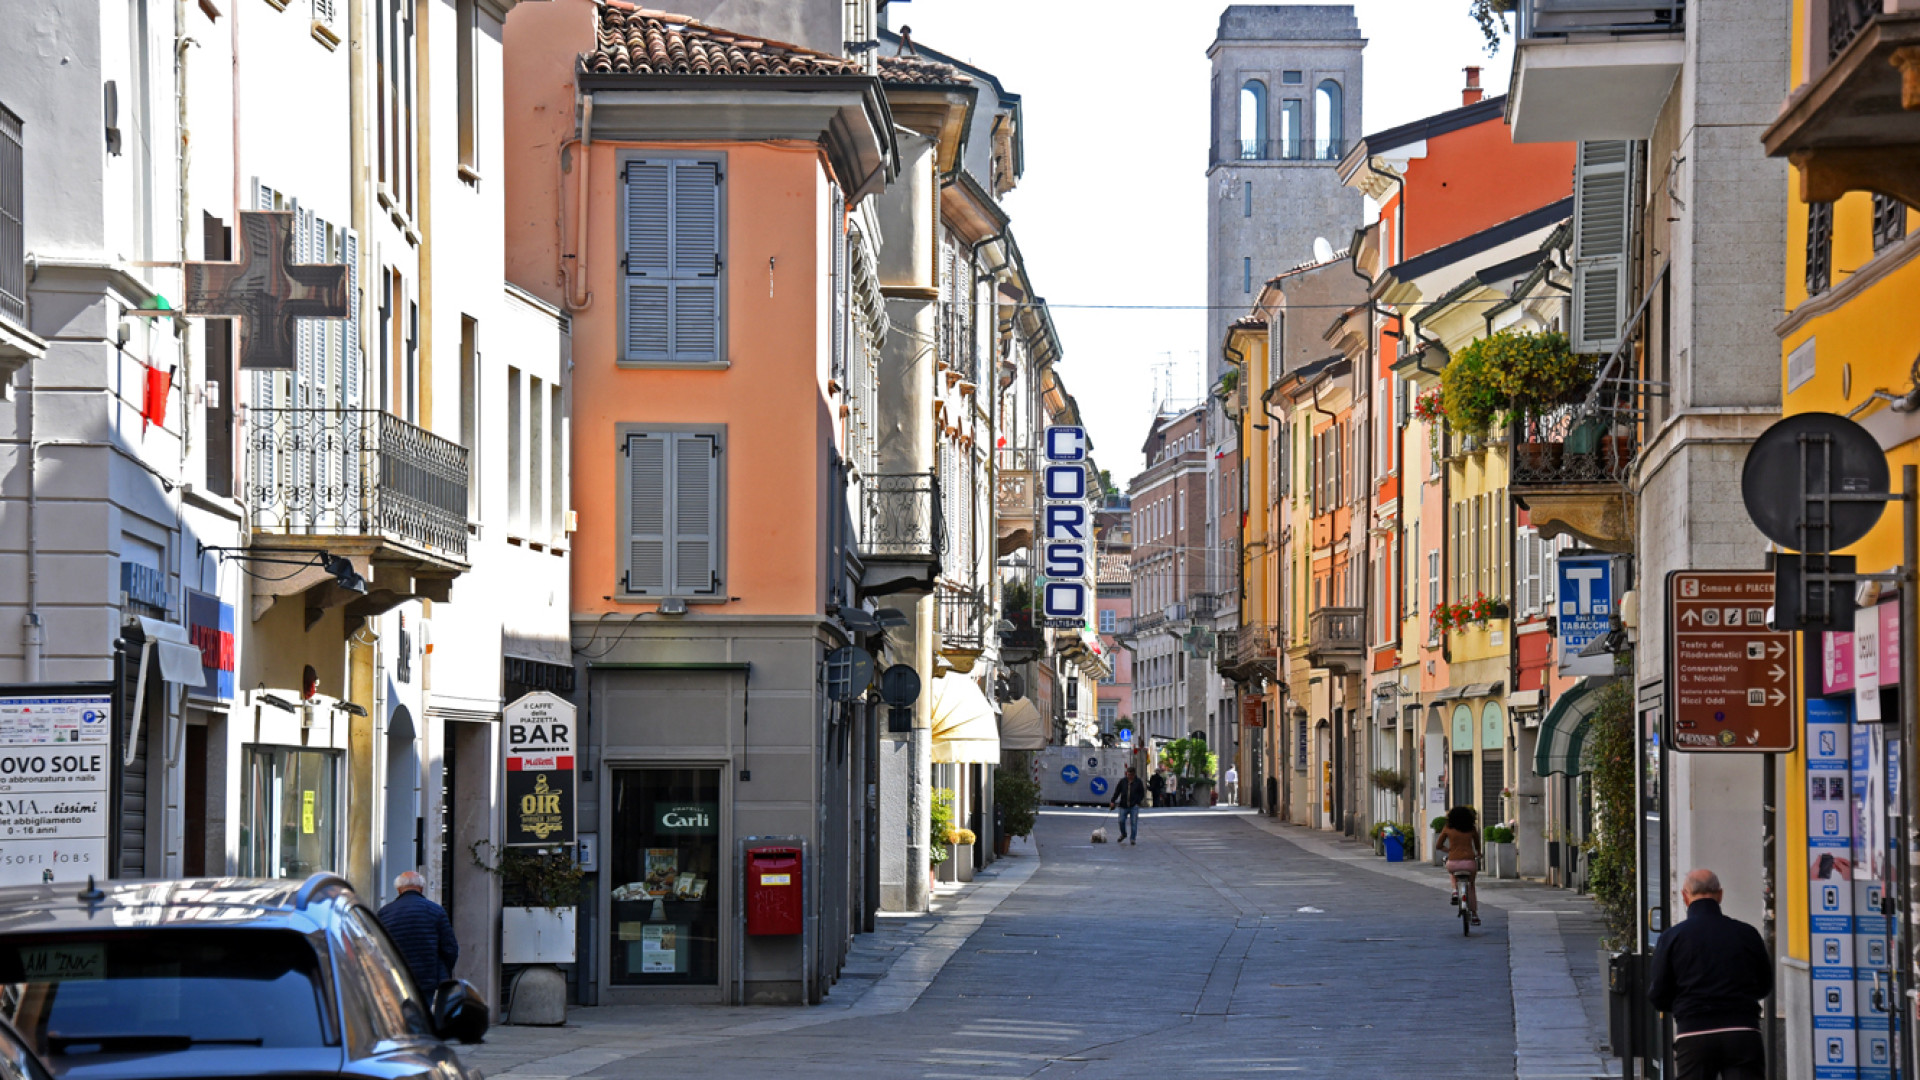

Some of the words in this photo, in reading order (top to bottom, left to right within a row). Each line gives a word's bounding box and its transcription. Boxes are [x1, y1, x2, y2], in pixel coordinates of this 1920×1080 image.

[1046, 428, 1084, 616] CORSO
[1566, 568, 1603, 614] T
[1701, 584, 1732, 593] Comune
[1734, 584, 1742, 593] di
[1746, 584, 1775, 593] PIACEN
[1044, 620, 1084, 628] MULTISALA
[1562, 622, 1609, 631] TABACCHI
[1680, 641, 1708, 649] Teatro
[1711, 641, 1724, 649] dei
[1680, 651, 1742, 659] Filodrammatici
[1680, 665, 1739, 673] Conservatorio
[1680, 675, 1690, 683] G.
[1693, 675, 1726, 683] Nicolini
[1681, 697, 1702, 705] Ricci
[1705, 697, 1726, 705] Oddi
[510, 724, 568, 744] BAR
[51, 755, 101, 773] SOLE
[522, 794, 560, 814] OIR
[13, 817, 82, 826] abbigliamento
[662, 811, 709, 828] Carli
[36, 826, 57, 834] anni
